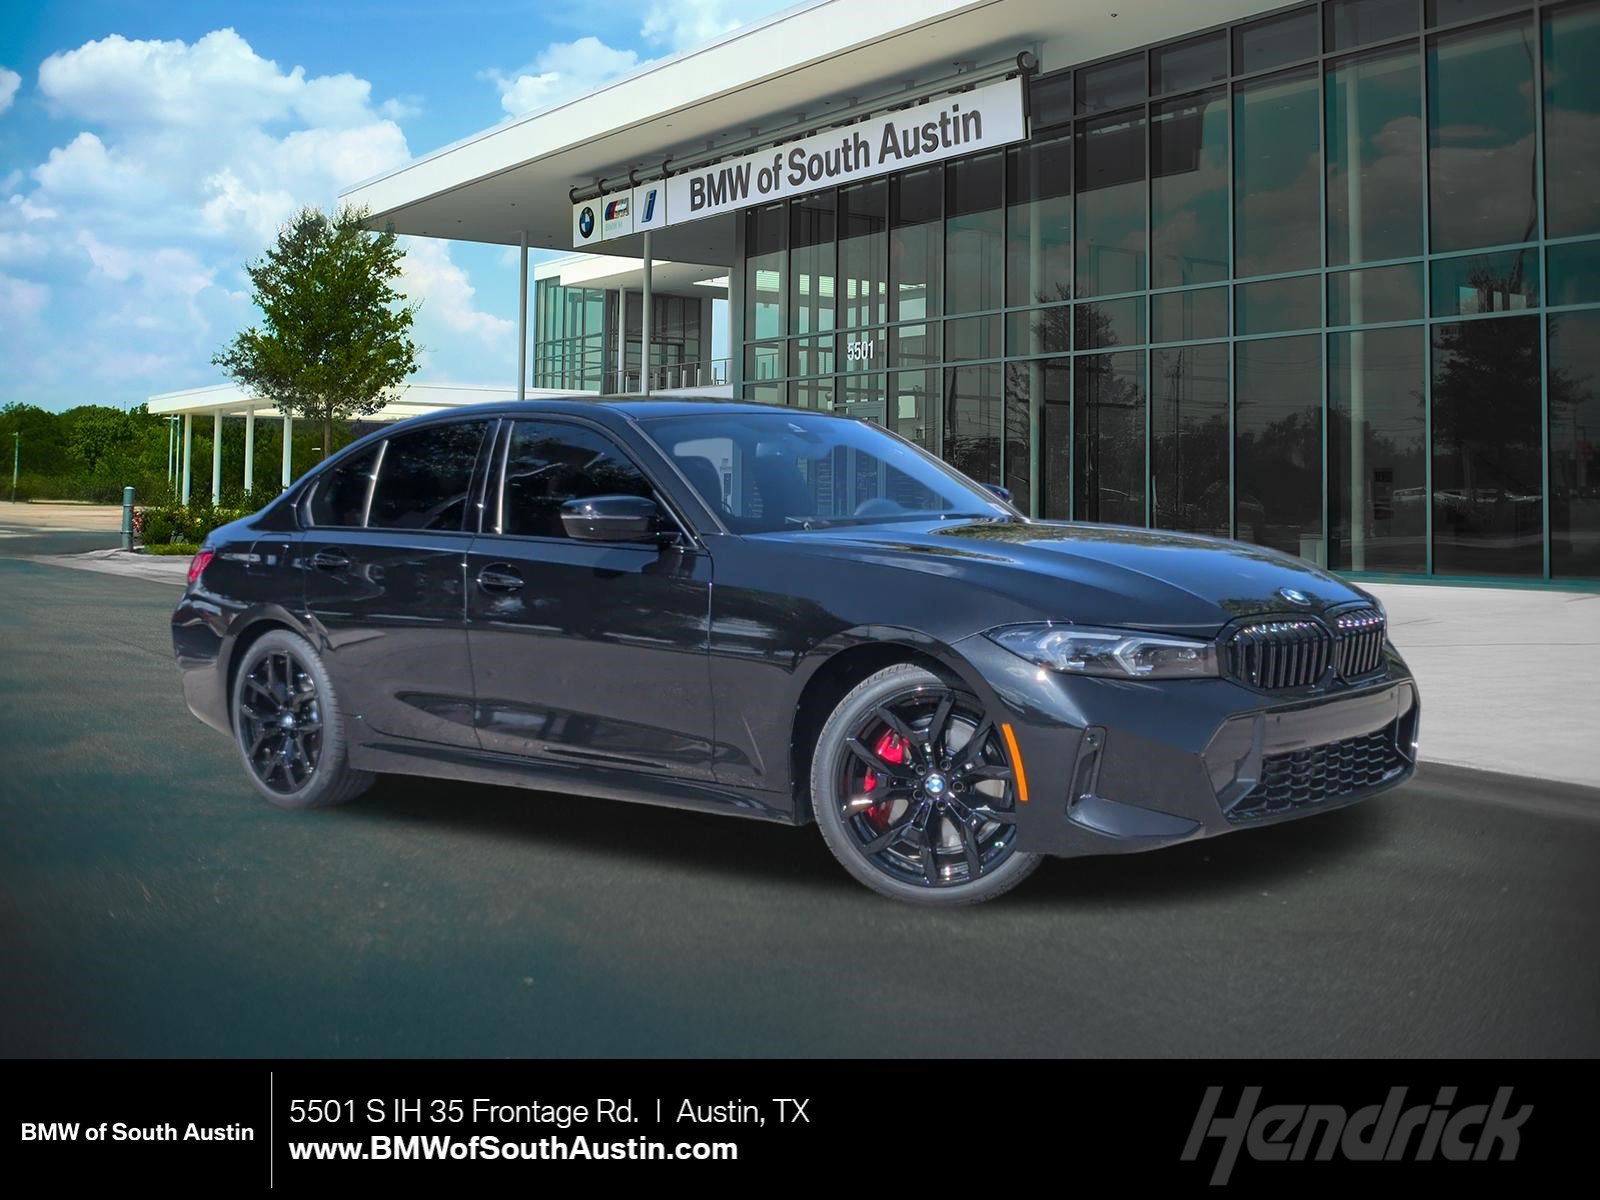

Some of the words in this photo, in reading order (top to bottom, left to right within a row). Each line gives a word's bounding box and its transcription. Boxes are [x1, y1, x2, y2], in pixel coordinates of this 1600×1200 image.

[689, 162, 752, 212] BMW
[757, 153, 783, 194] of
[788, 132, 871, 187] South
[878, 103, 982, 165] Austin
[847, 340, 873, 361] 5501
